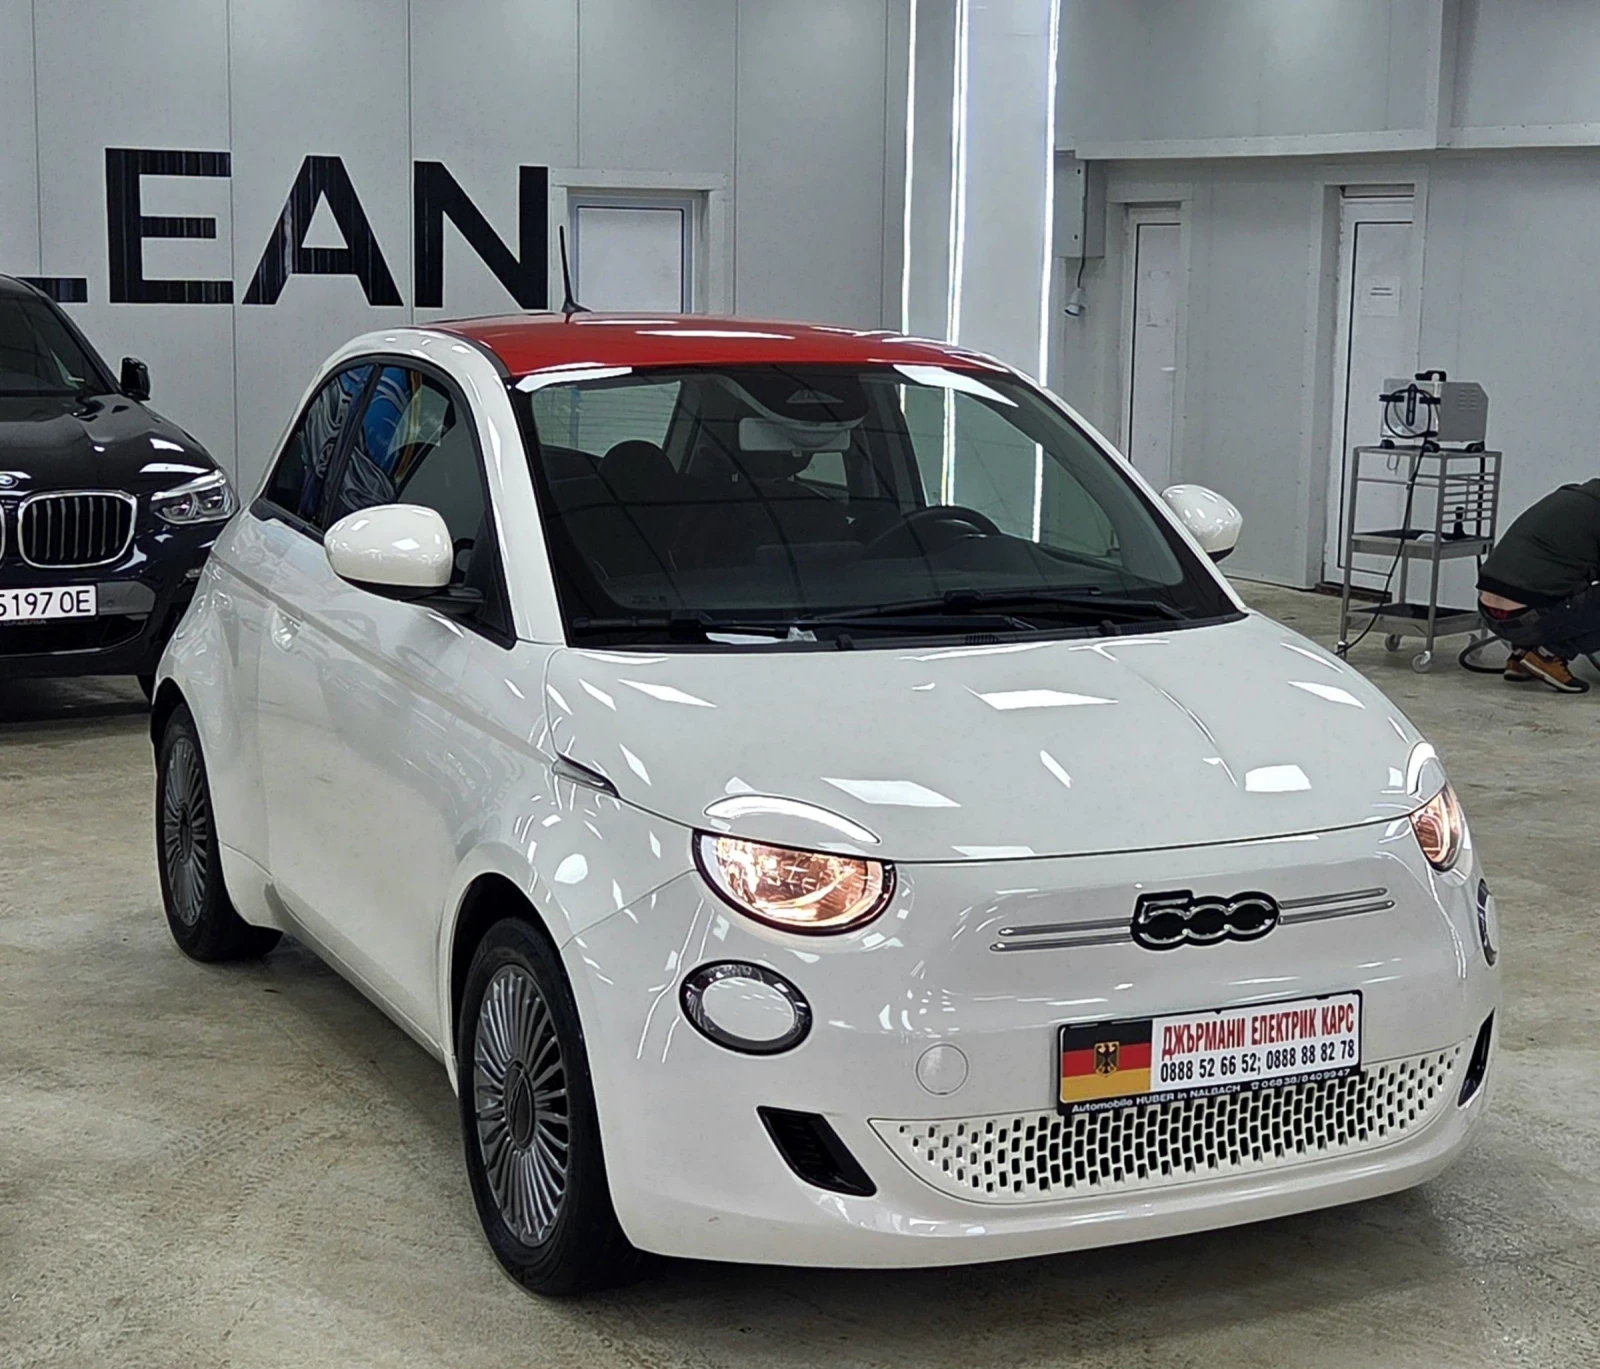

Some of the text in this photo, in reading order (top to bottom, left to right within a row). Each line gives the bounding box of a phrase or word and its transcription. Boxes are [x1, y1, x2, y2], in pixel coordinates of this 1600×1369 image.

[16, 148, 549, 309] EAN
[1132, 891, 1278, 949] 500
[1160, 1038, 1355, 1082] 0888 52 66 52; 0888 88 82 78
[1161, 1002, 1355, 1061] ДЖЪРМАНИ ЕЛЕКТРИК КАРС
[1071, 1098, 1133, 1113] Automobile
[1136, 1092, 1175, 1105] HUBER
[1189, 1084, 1241, 1098] NALBACH
